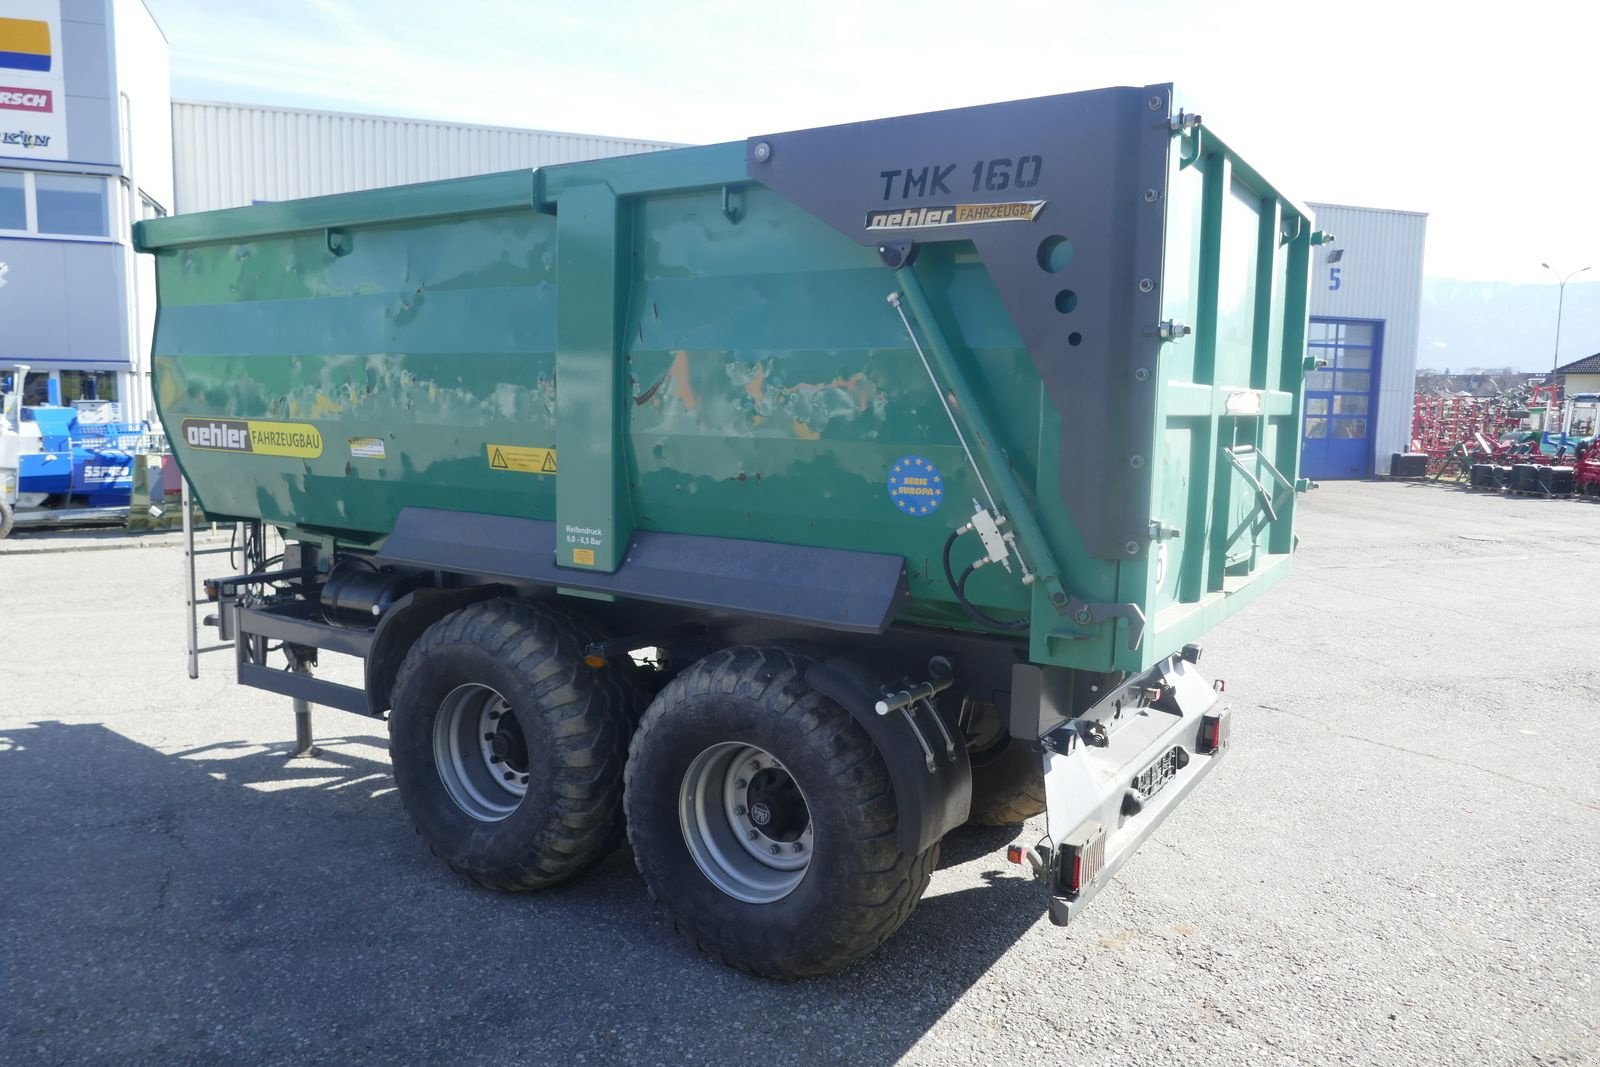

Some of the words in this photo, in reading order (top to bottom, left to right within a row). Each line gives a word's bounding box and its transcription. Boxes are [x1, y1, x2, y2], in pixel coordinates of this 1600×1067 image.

[880, 163, 957, 200] TMK
[972, 155, 1043, 193] 160
[959, 203, 1034, 221] FAHRZEUGBA
[1329, 267, 1341, 291] 5
[187, 423, 248, 449] oehler
[251, 430, 321, 449] FAHRZEUGBAU
[898, 486, 933, 495] EUROPA
[590, 537, 601, 545] Bar
